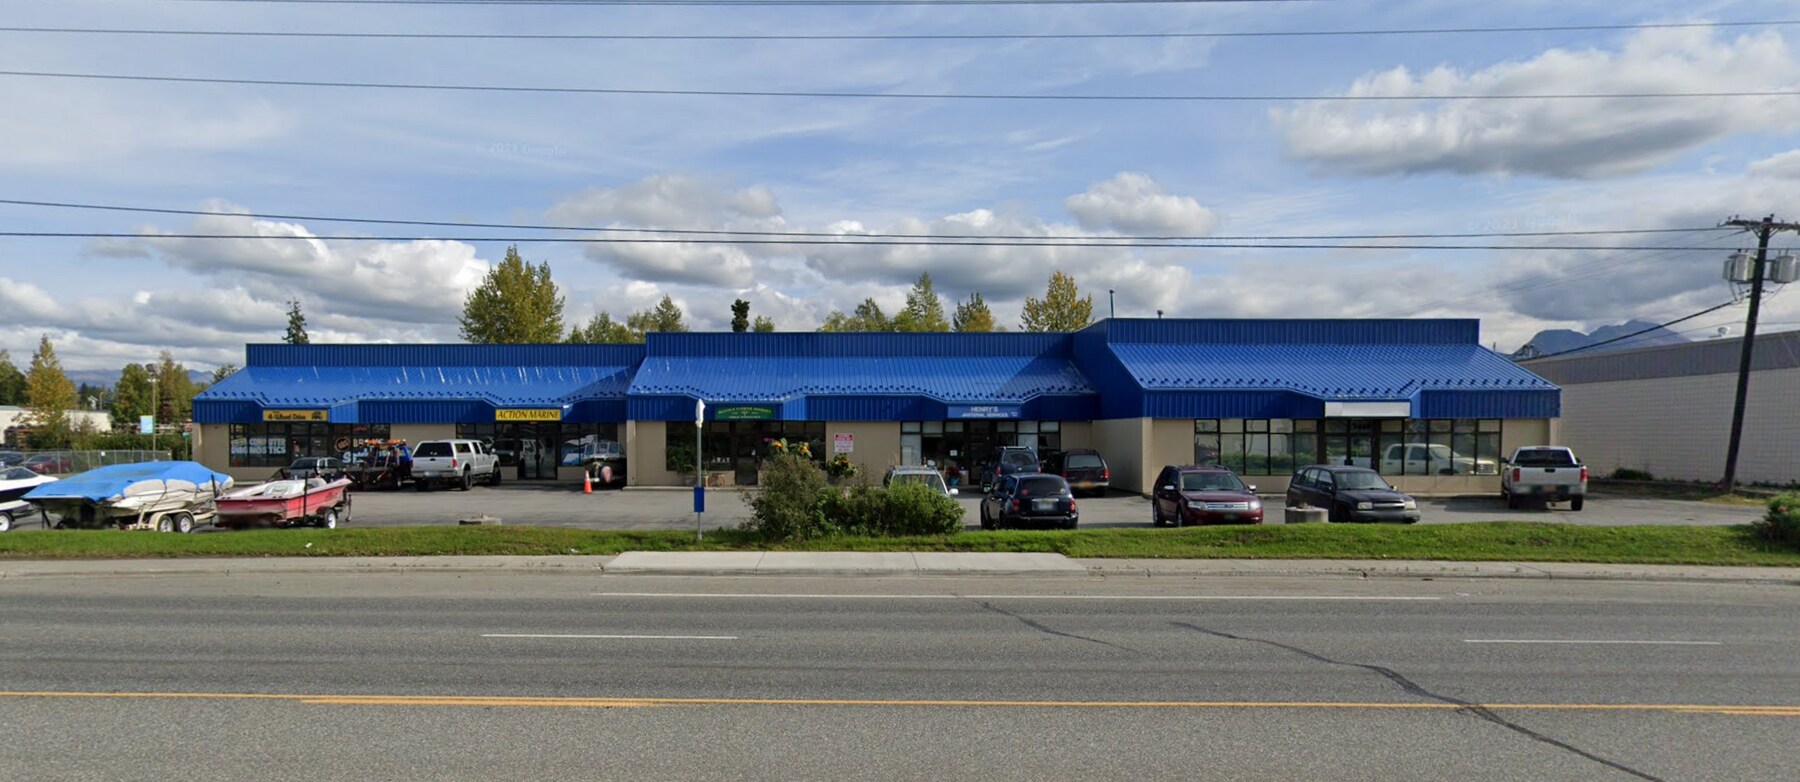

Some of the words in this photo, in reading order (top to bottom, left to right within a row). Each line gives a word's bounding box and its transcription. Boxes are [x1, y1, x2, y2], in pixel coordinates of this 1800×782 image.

[499, 411, 528, 419] ACTION
[529, 411, 559, 419] MARINE
[249, 438, 286, 446] COMPUTER
[231, 446, 286, 454] DIAGNOSTICS
